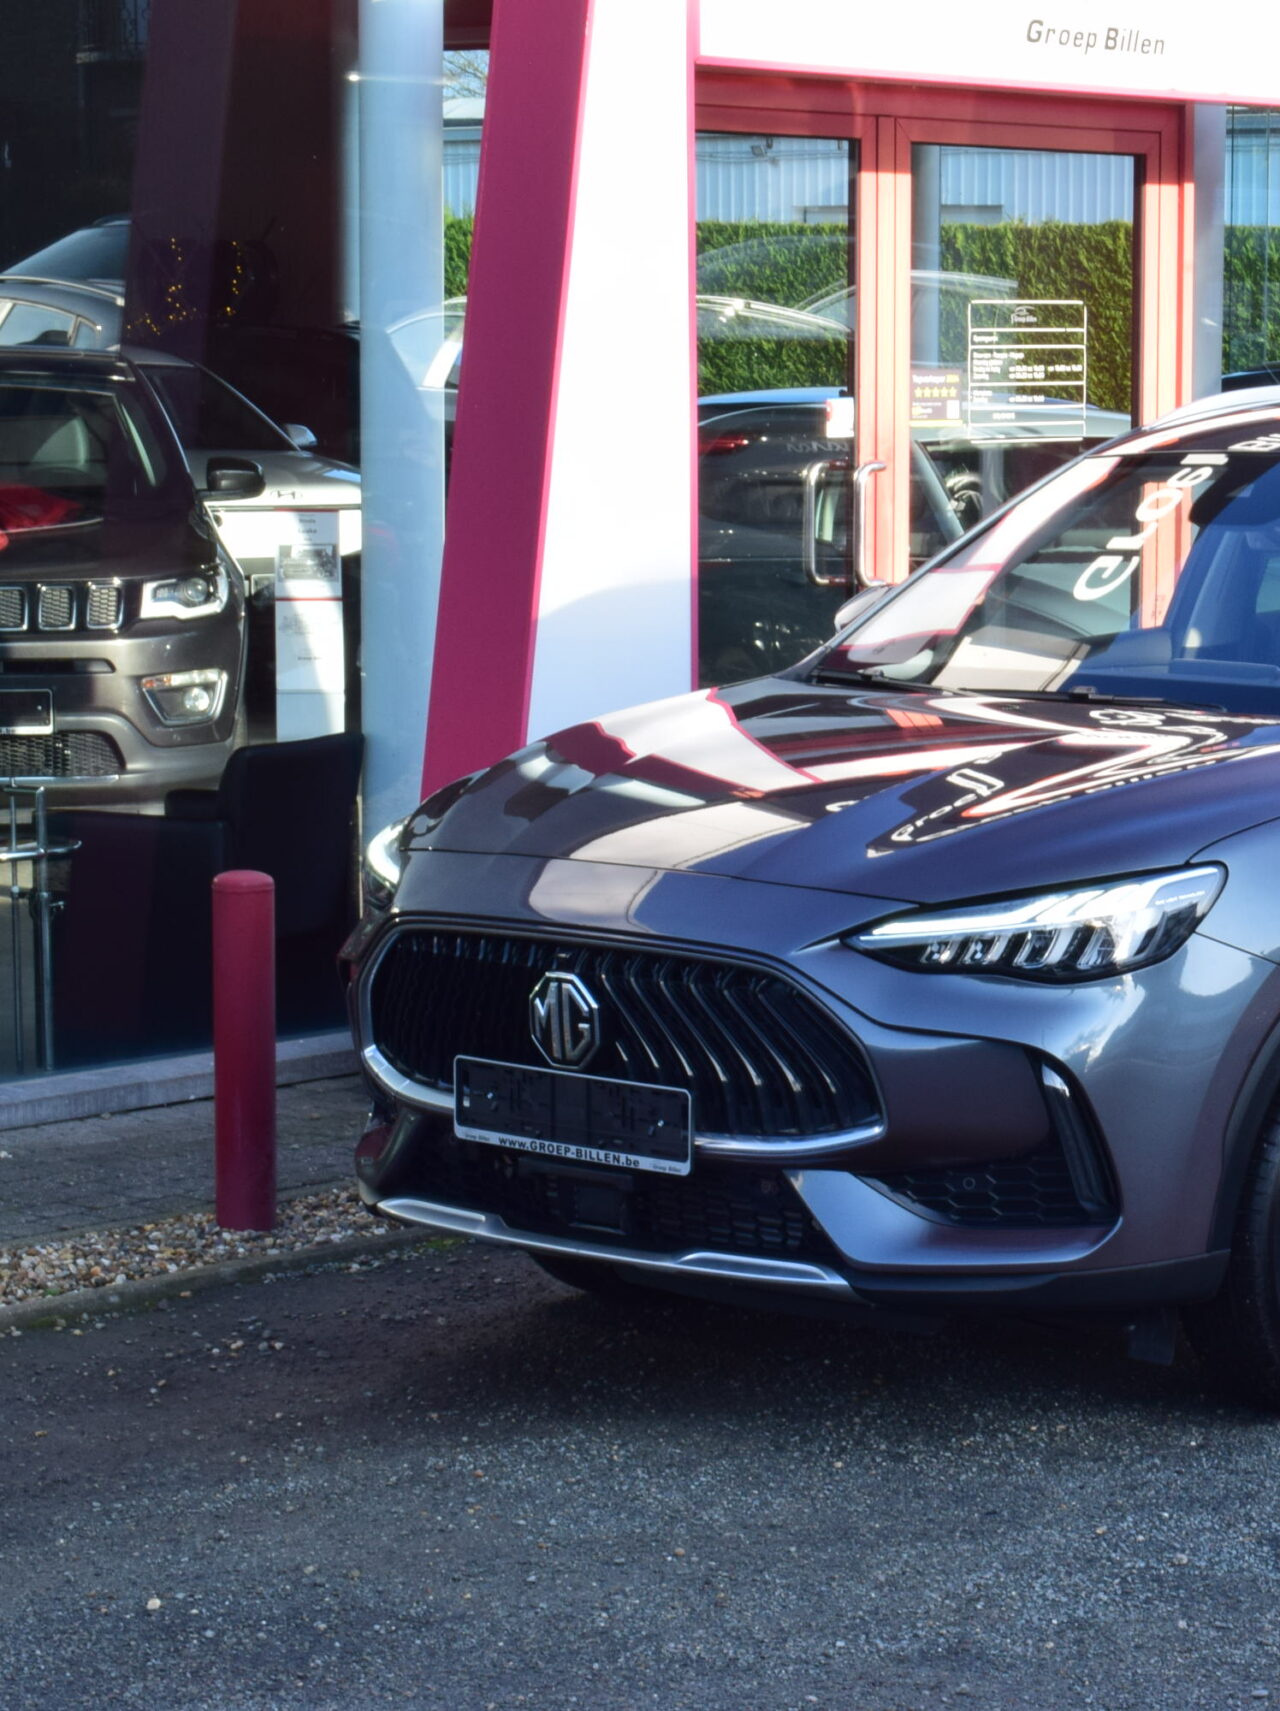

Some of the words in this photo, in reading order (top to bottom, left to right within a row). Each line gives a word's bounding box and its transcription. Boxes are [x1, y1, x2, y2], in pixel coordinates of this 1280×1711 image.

[1026, 19, 1098, 55] Groep
[1104, 27, 1165, 55] Billen
[534, 982, 592, 1060] MG
[498, 1136, 641, 1168] www.GROEP-BILLEN.be
